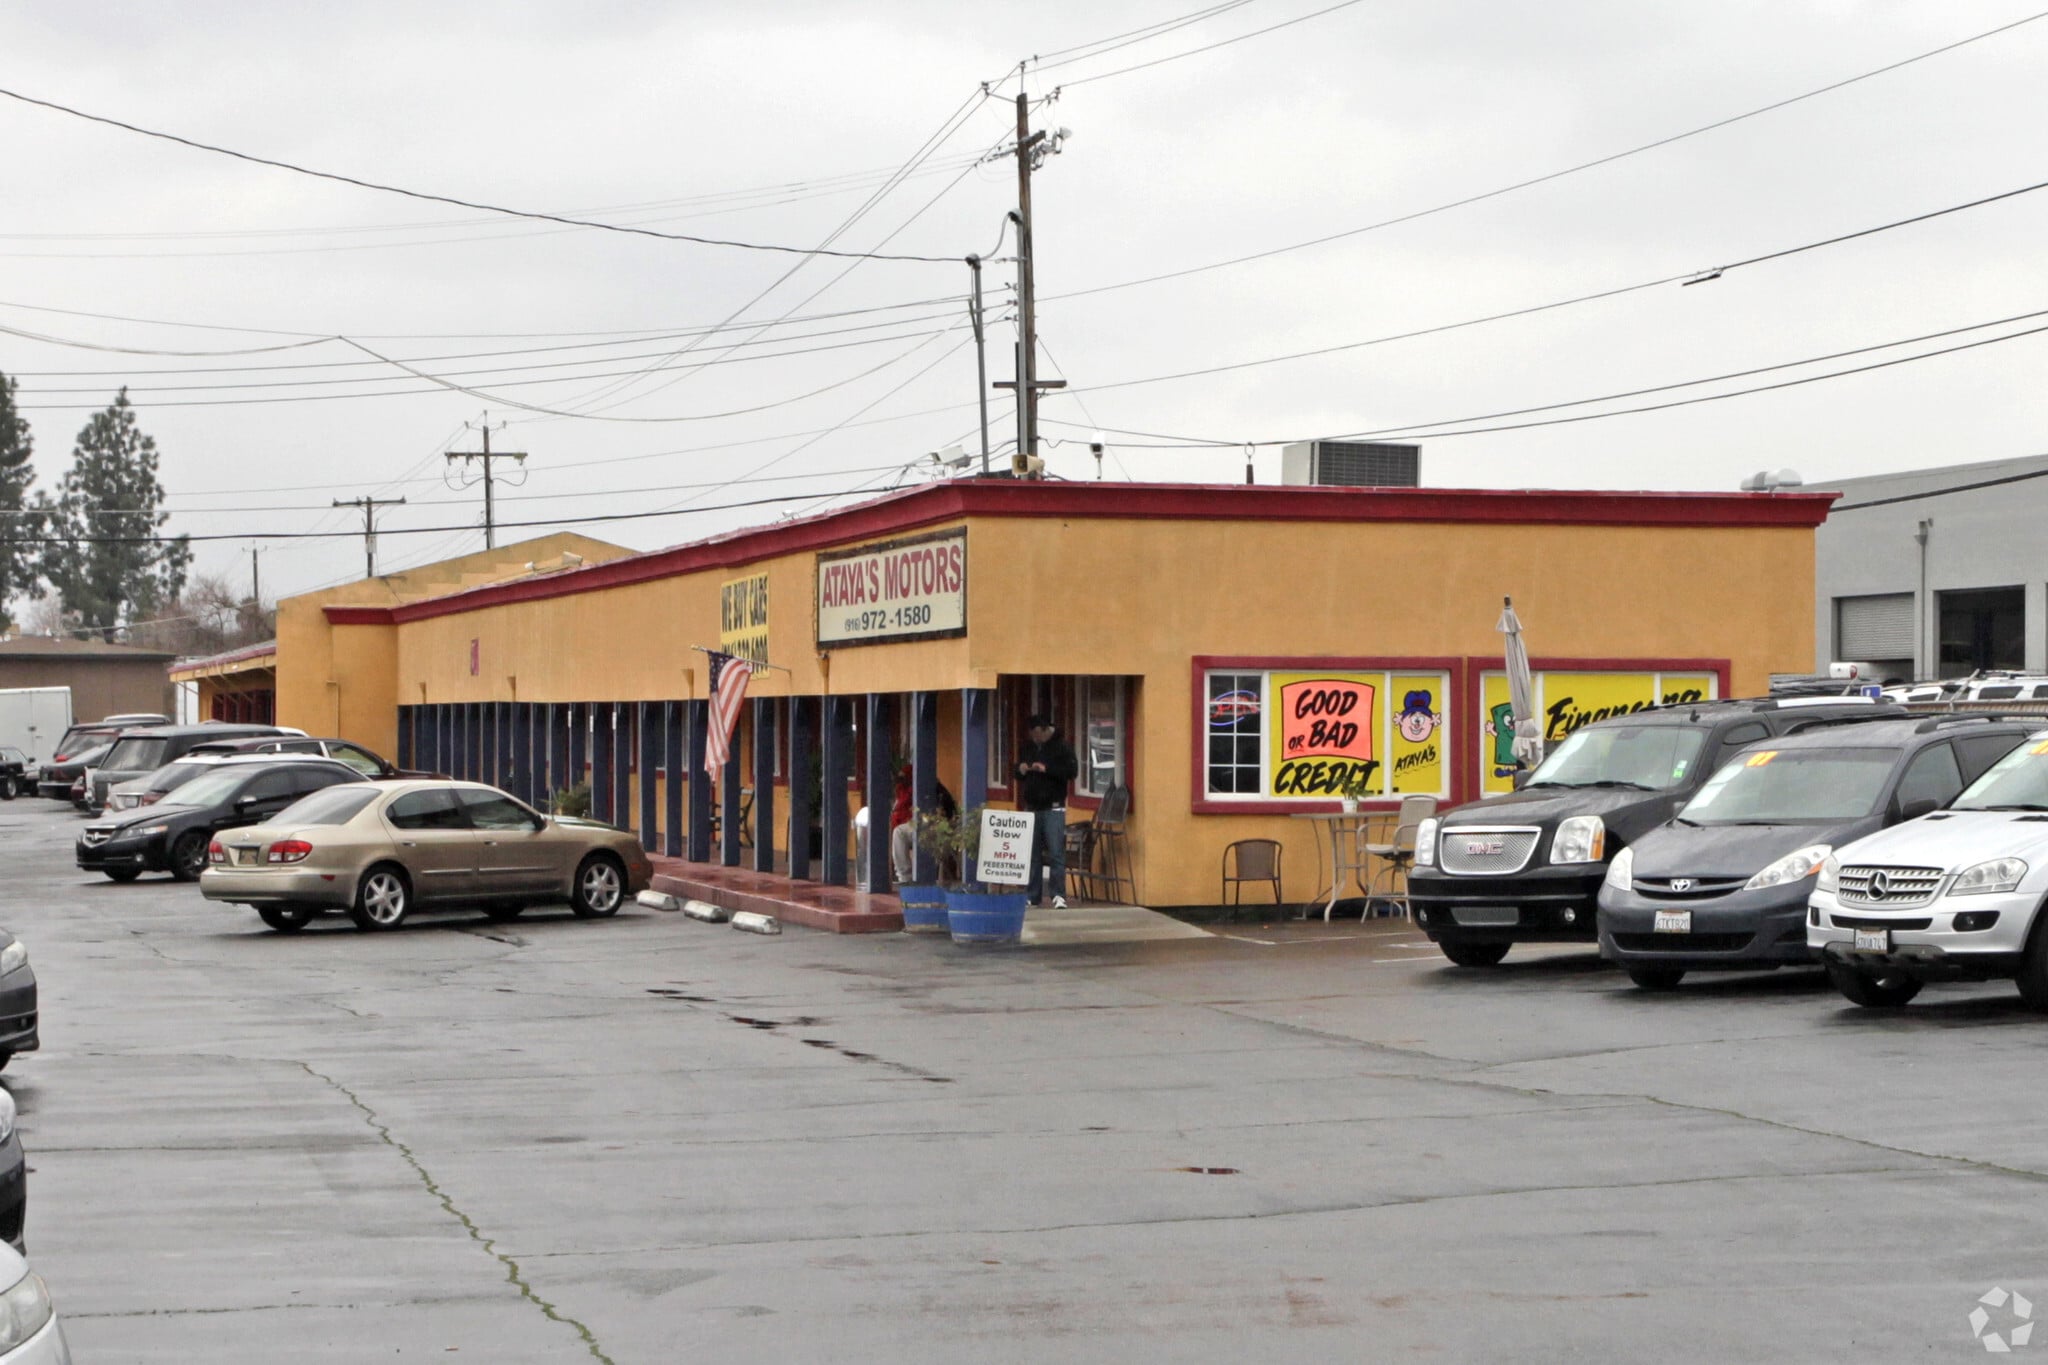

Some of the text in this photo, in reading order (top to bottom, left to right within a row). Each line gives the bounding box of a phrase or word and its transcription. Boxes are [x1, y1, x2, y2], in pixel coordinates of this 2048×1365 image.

[822, 545, 961, 608] ATAYA'S MOTORS
[750, 575, 768, 627] CARS
[1295, 689, 1358, 720] GOOD
[1288, 720, 1358, 750] OR BAD
[1394, 744, 1436, 772] ATAYA'S
[989, 815, 1027, 829] Caution
[993, 829, 1021, 839] Slow
[1002, 841, 1010, 850] 5
[1467, 842, 1503, 855] GMC
[994, 851, 1016, 860] MPH
[983, 861, 1025, 870] PEDESTRIAN
[985, 868, 1022, 879] Crossing
